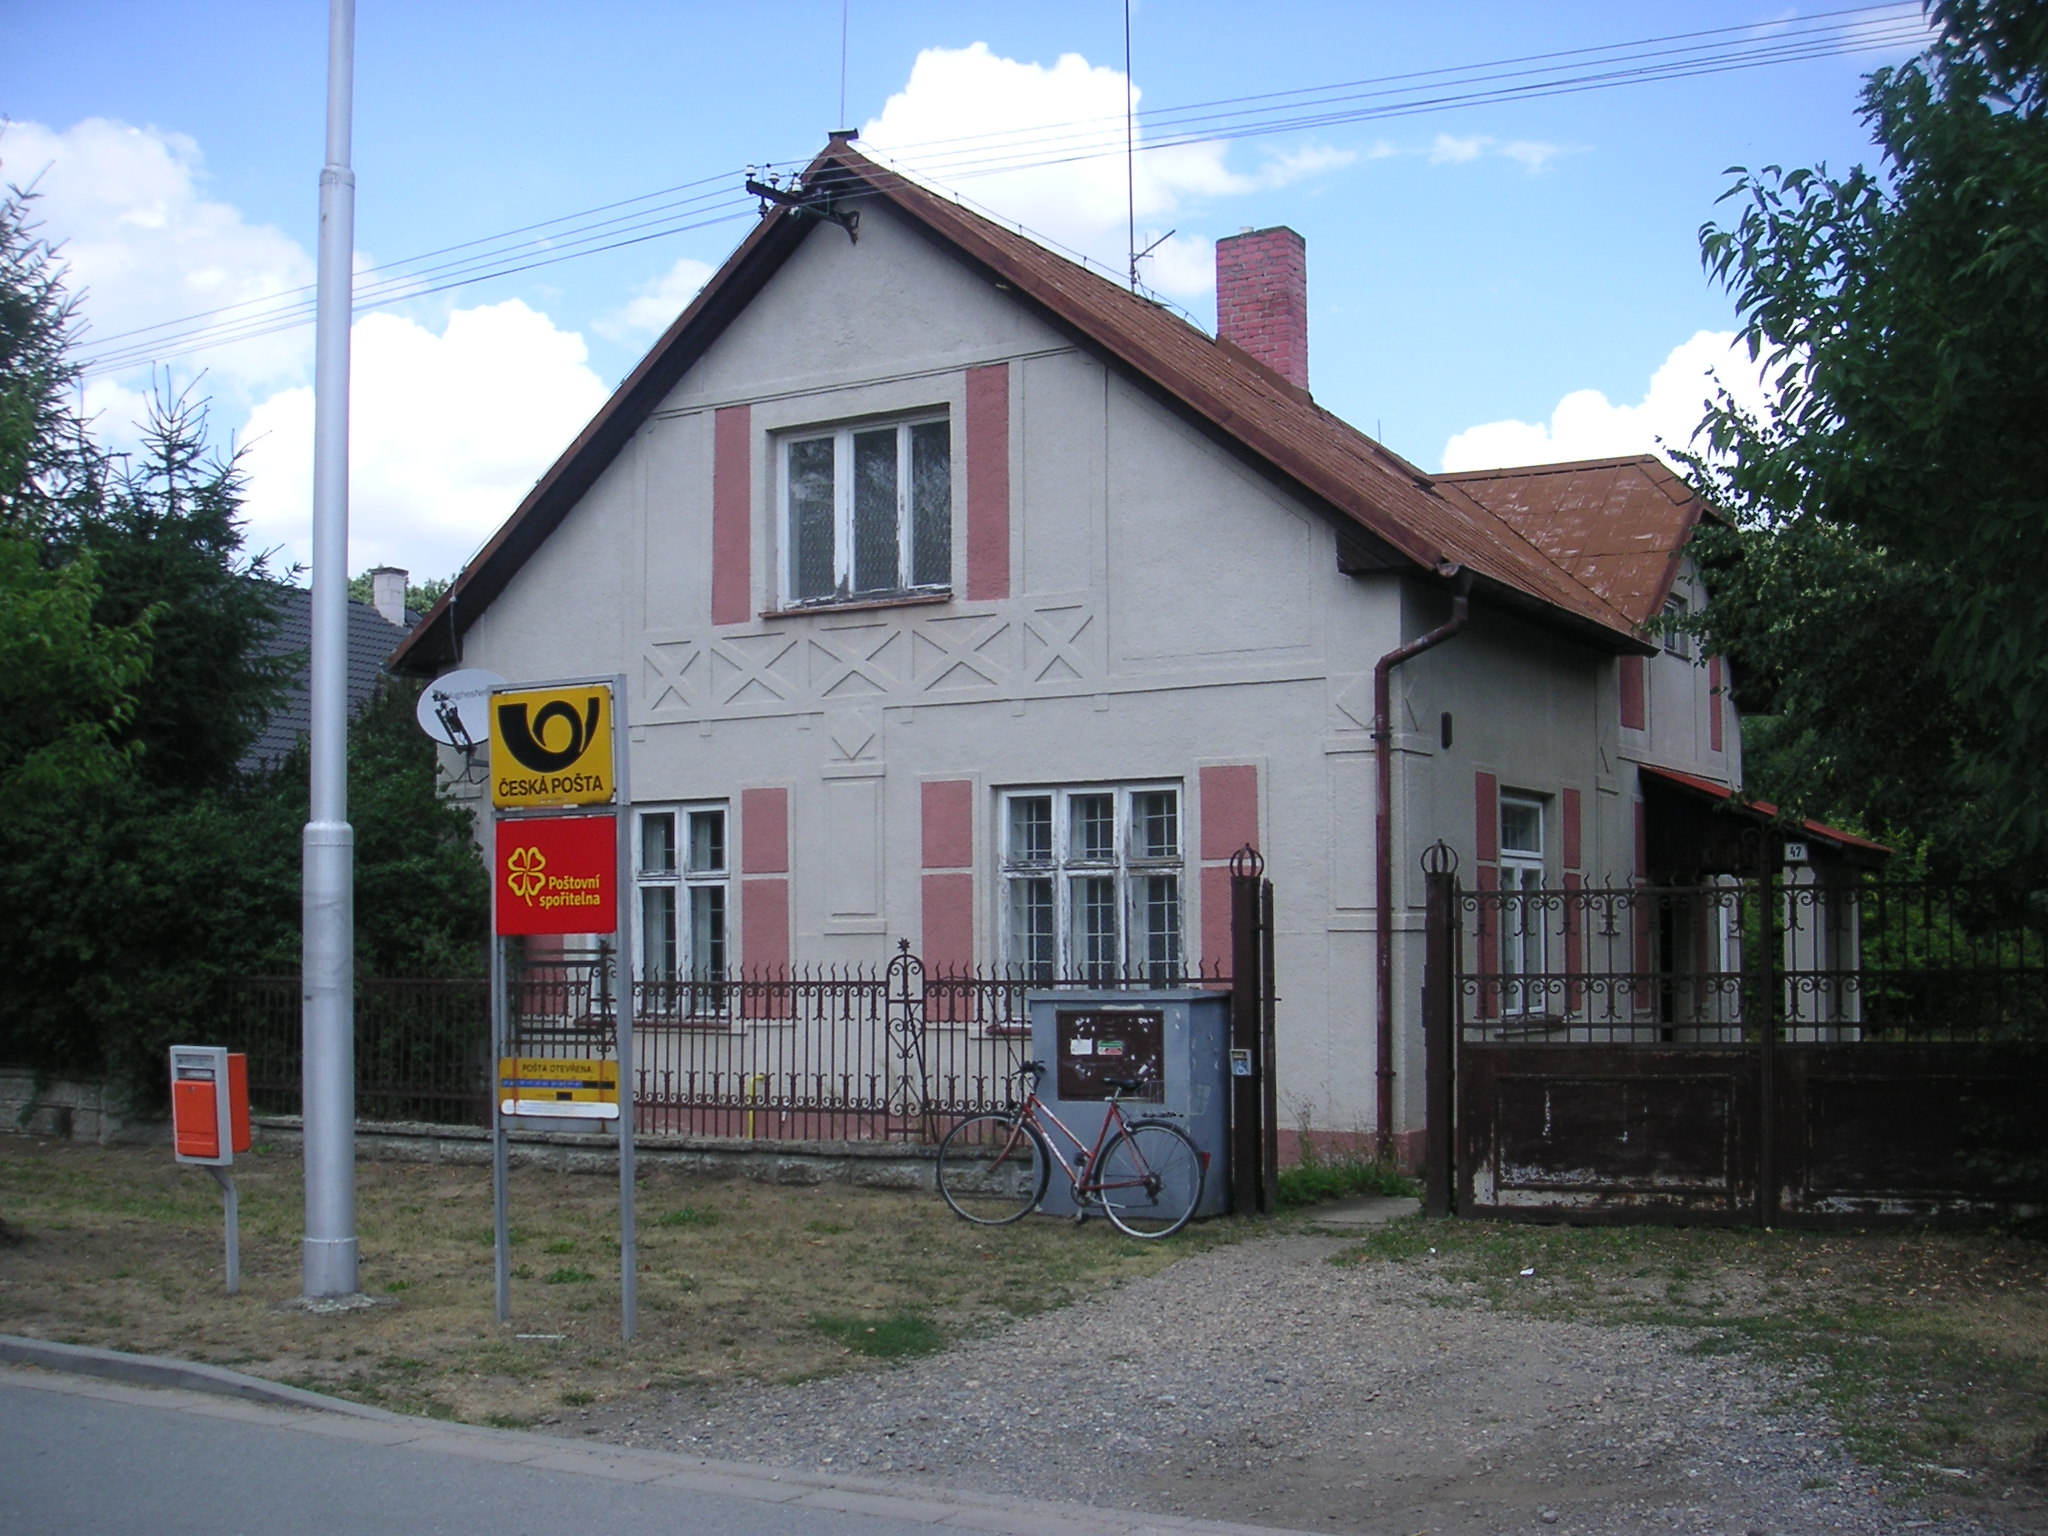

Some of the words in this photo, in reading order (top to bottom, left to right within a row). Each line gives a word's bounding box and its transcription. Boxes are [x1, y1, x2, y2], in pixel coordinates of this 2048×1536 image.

[499, 776, 549, 797] ČESKÁ
[551, 773, 603, 794] POŠTA
[1789, 846, 1801, 857] 47
[549, 874, 600, 890] Poštovní
[539, 891, 600, 910] spořitelna
[522, 1062, 547, 1073] POŠTA
